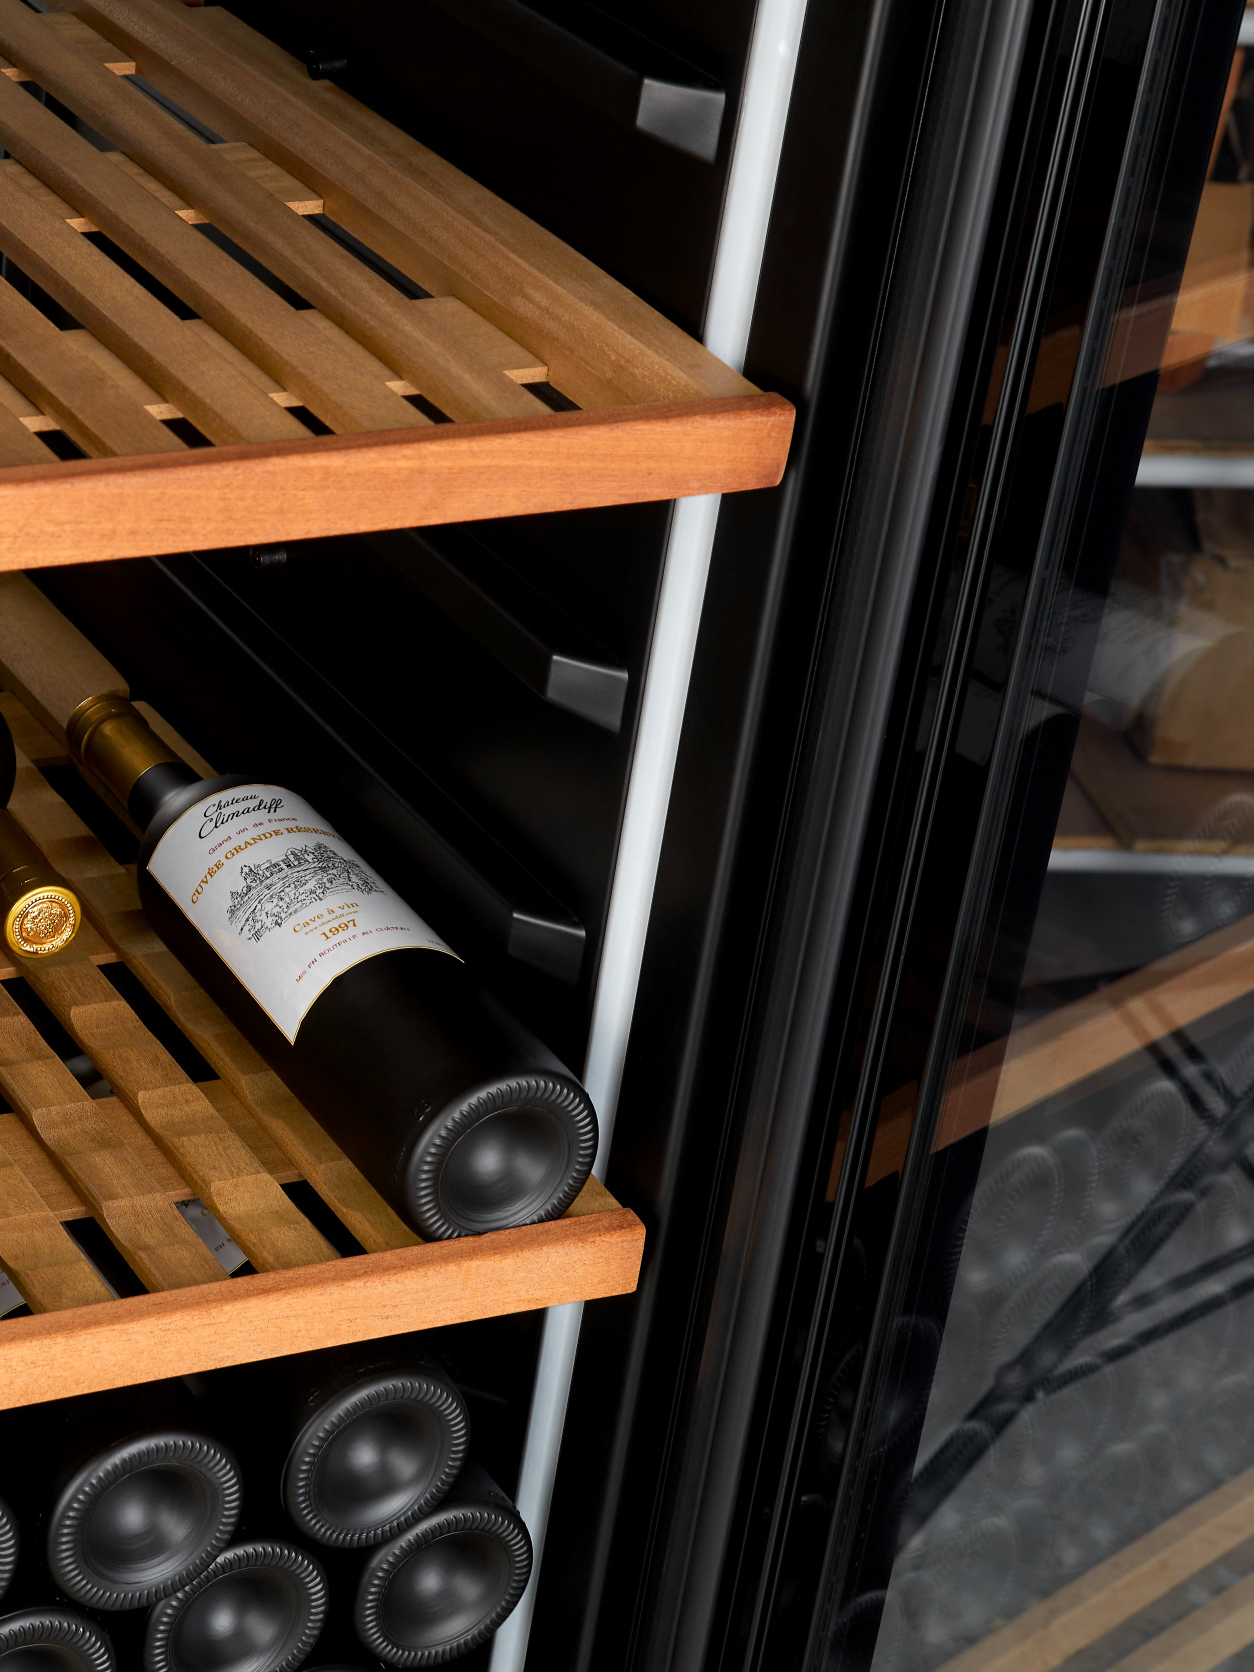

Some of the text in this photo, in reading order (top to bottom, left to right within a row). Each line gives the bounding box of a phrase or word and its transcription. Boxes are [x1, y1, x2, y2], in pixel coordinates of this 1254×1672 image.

[198, 798, 285, 839] Climadiff
[208, 835, 232, 855] Grand
[235, 826, 249, 835] vin
[267, 816, 298, 824] France
[190, 859, 225, 905] CUVÉE
[224, 828, 283, 861] GRANDE
[292, 902, 360, 933] Cave à vin
[320, 918, 358, 941] 1997
